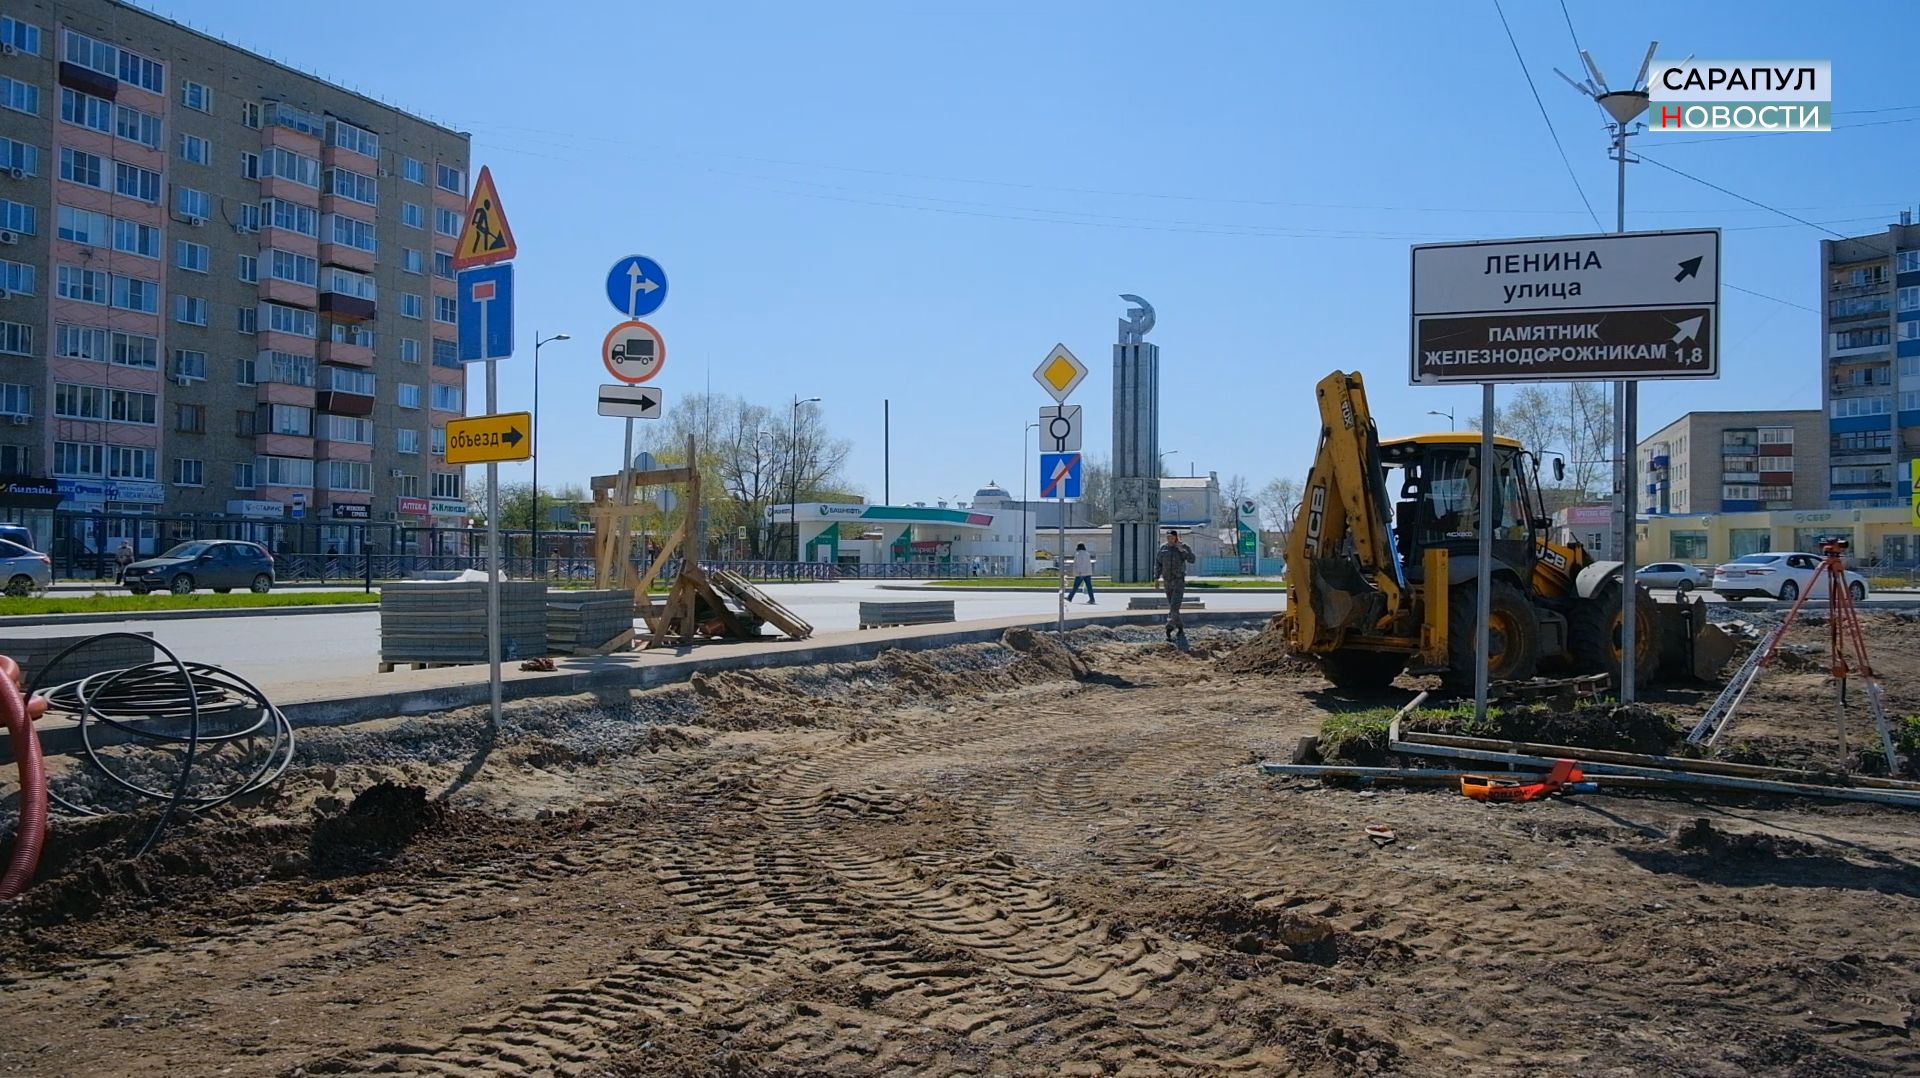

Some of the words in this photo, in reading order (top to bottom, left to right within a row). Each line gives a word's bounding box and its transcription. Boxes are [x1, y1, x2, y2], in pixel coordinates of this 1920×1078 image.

[1484, 250, 1603, 275] ЛЕНИНА
[1503, 281, 1583, 304] улица
[1488, 323, 1600, 342] ПАМЯТНИК
[1424, 343, 1667, 367] ЖЕЛЕЗНОДОРОЖНИКАМ
[1674, 347, 1704, 368] 1,8
[449, 430, 500, 449] объезд
[9, 483, 53, 495] билайн
[402, 502, 428, 511] АПТЕКА
[1305, 486, 1325, 557] JCB
[1536, 544, 1566, 569] JCB
